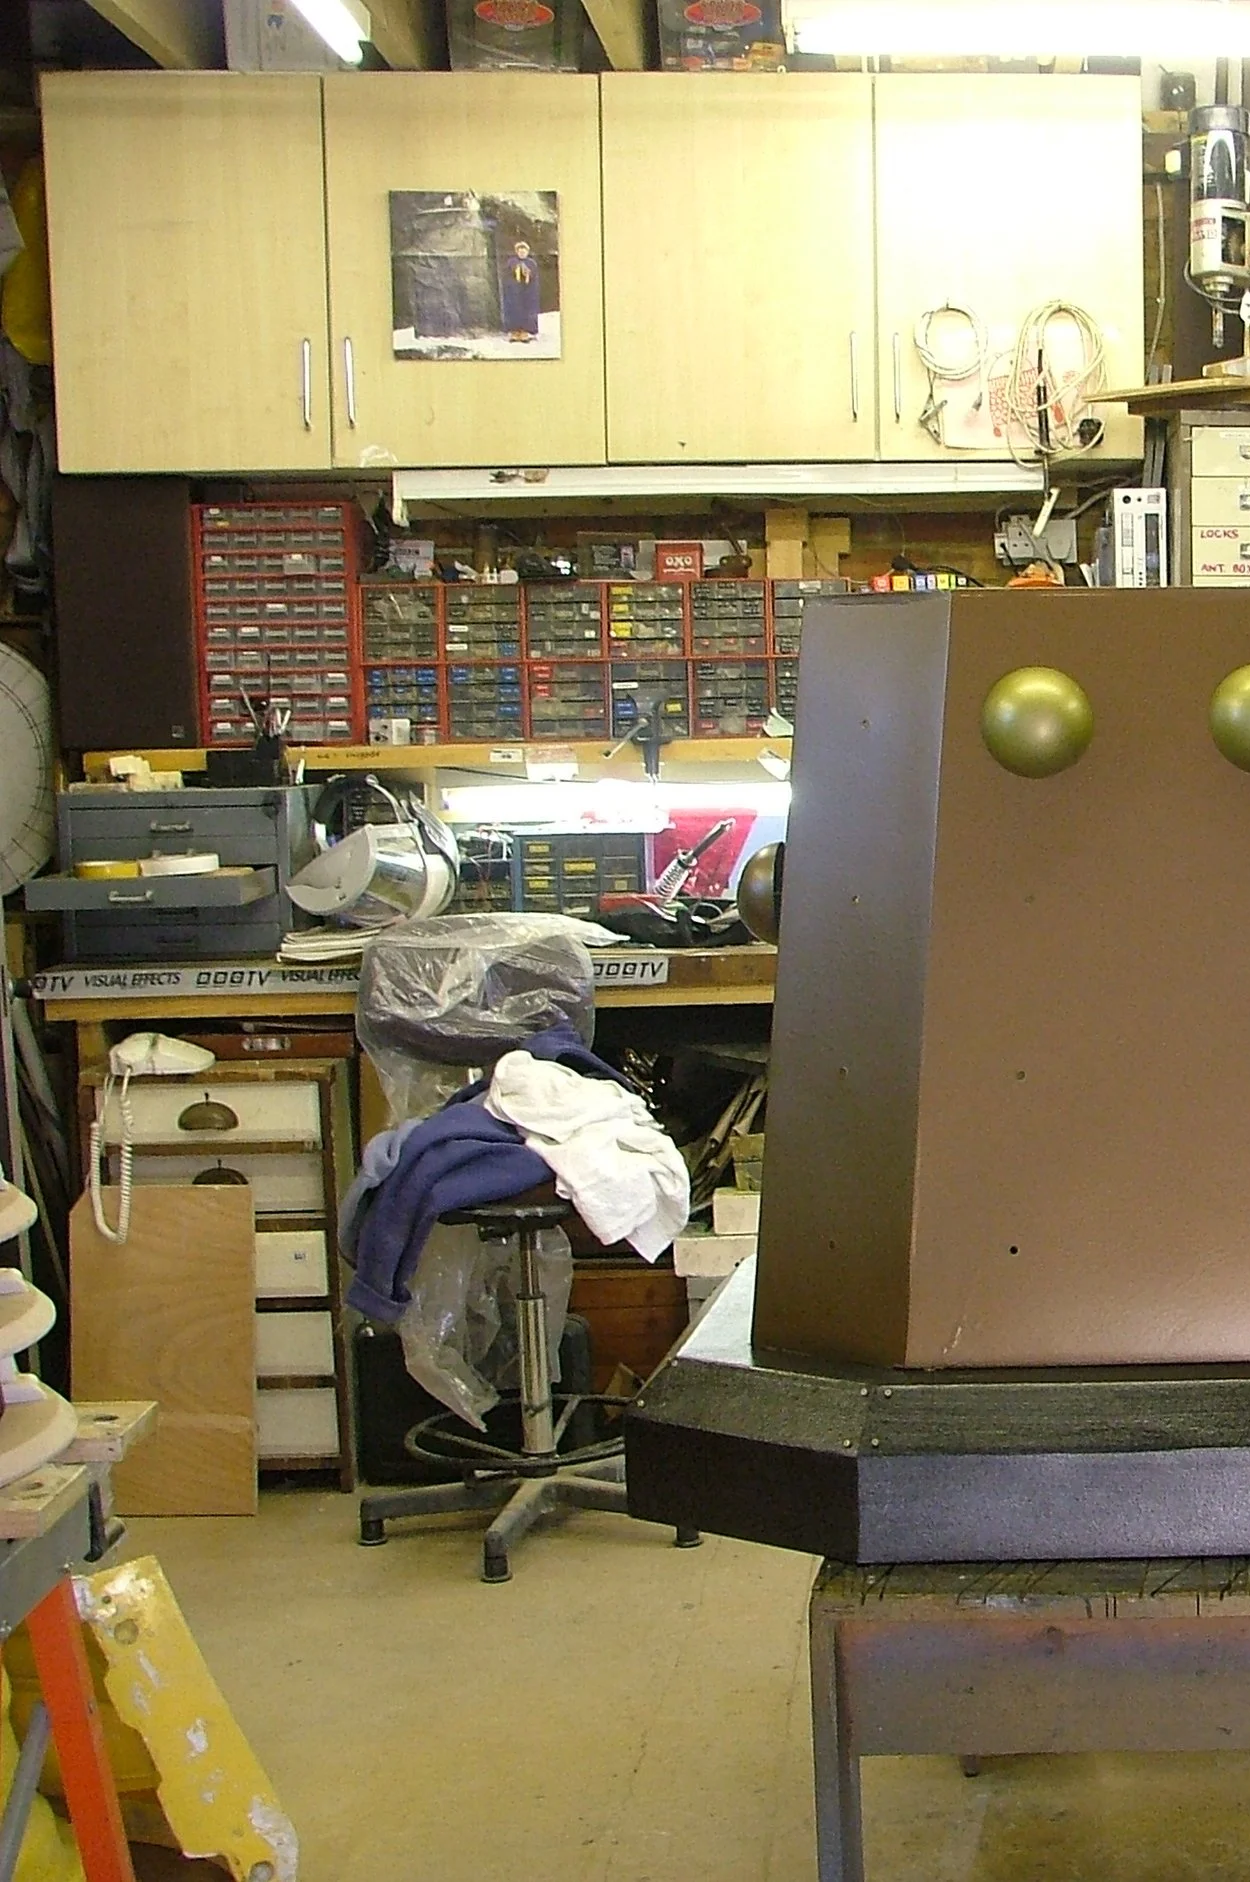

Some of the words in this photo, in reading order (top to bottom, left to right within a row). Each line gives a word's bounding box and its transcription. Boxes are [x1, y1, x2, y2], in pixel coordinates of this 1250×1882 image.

[1200, 529, 1239, 539] LOCKS
[665, 555, 693, 567] OXO
[84, 974, 127, 988] VISUAL
[131, 972, 182, 986] EFFECTS
[281, 969, 325, 983] VISUAL
